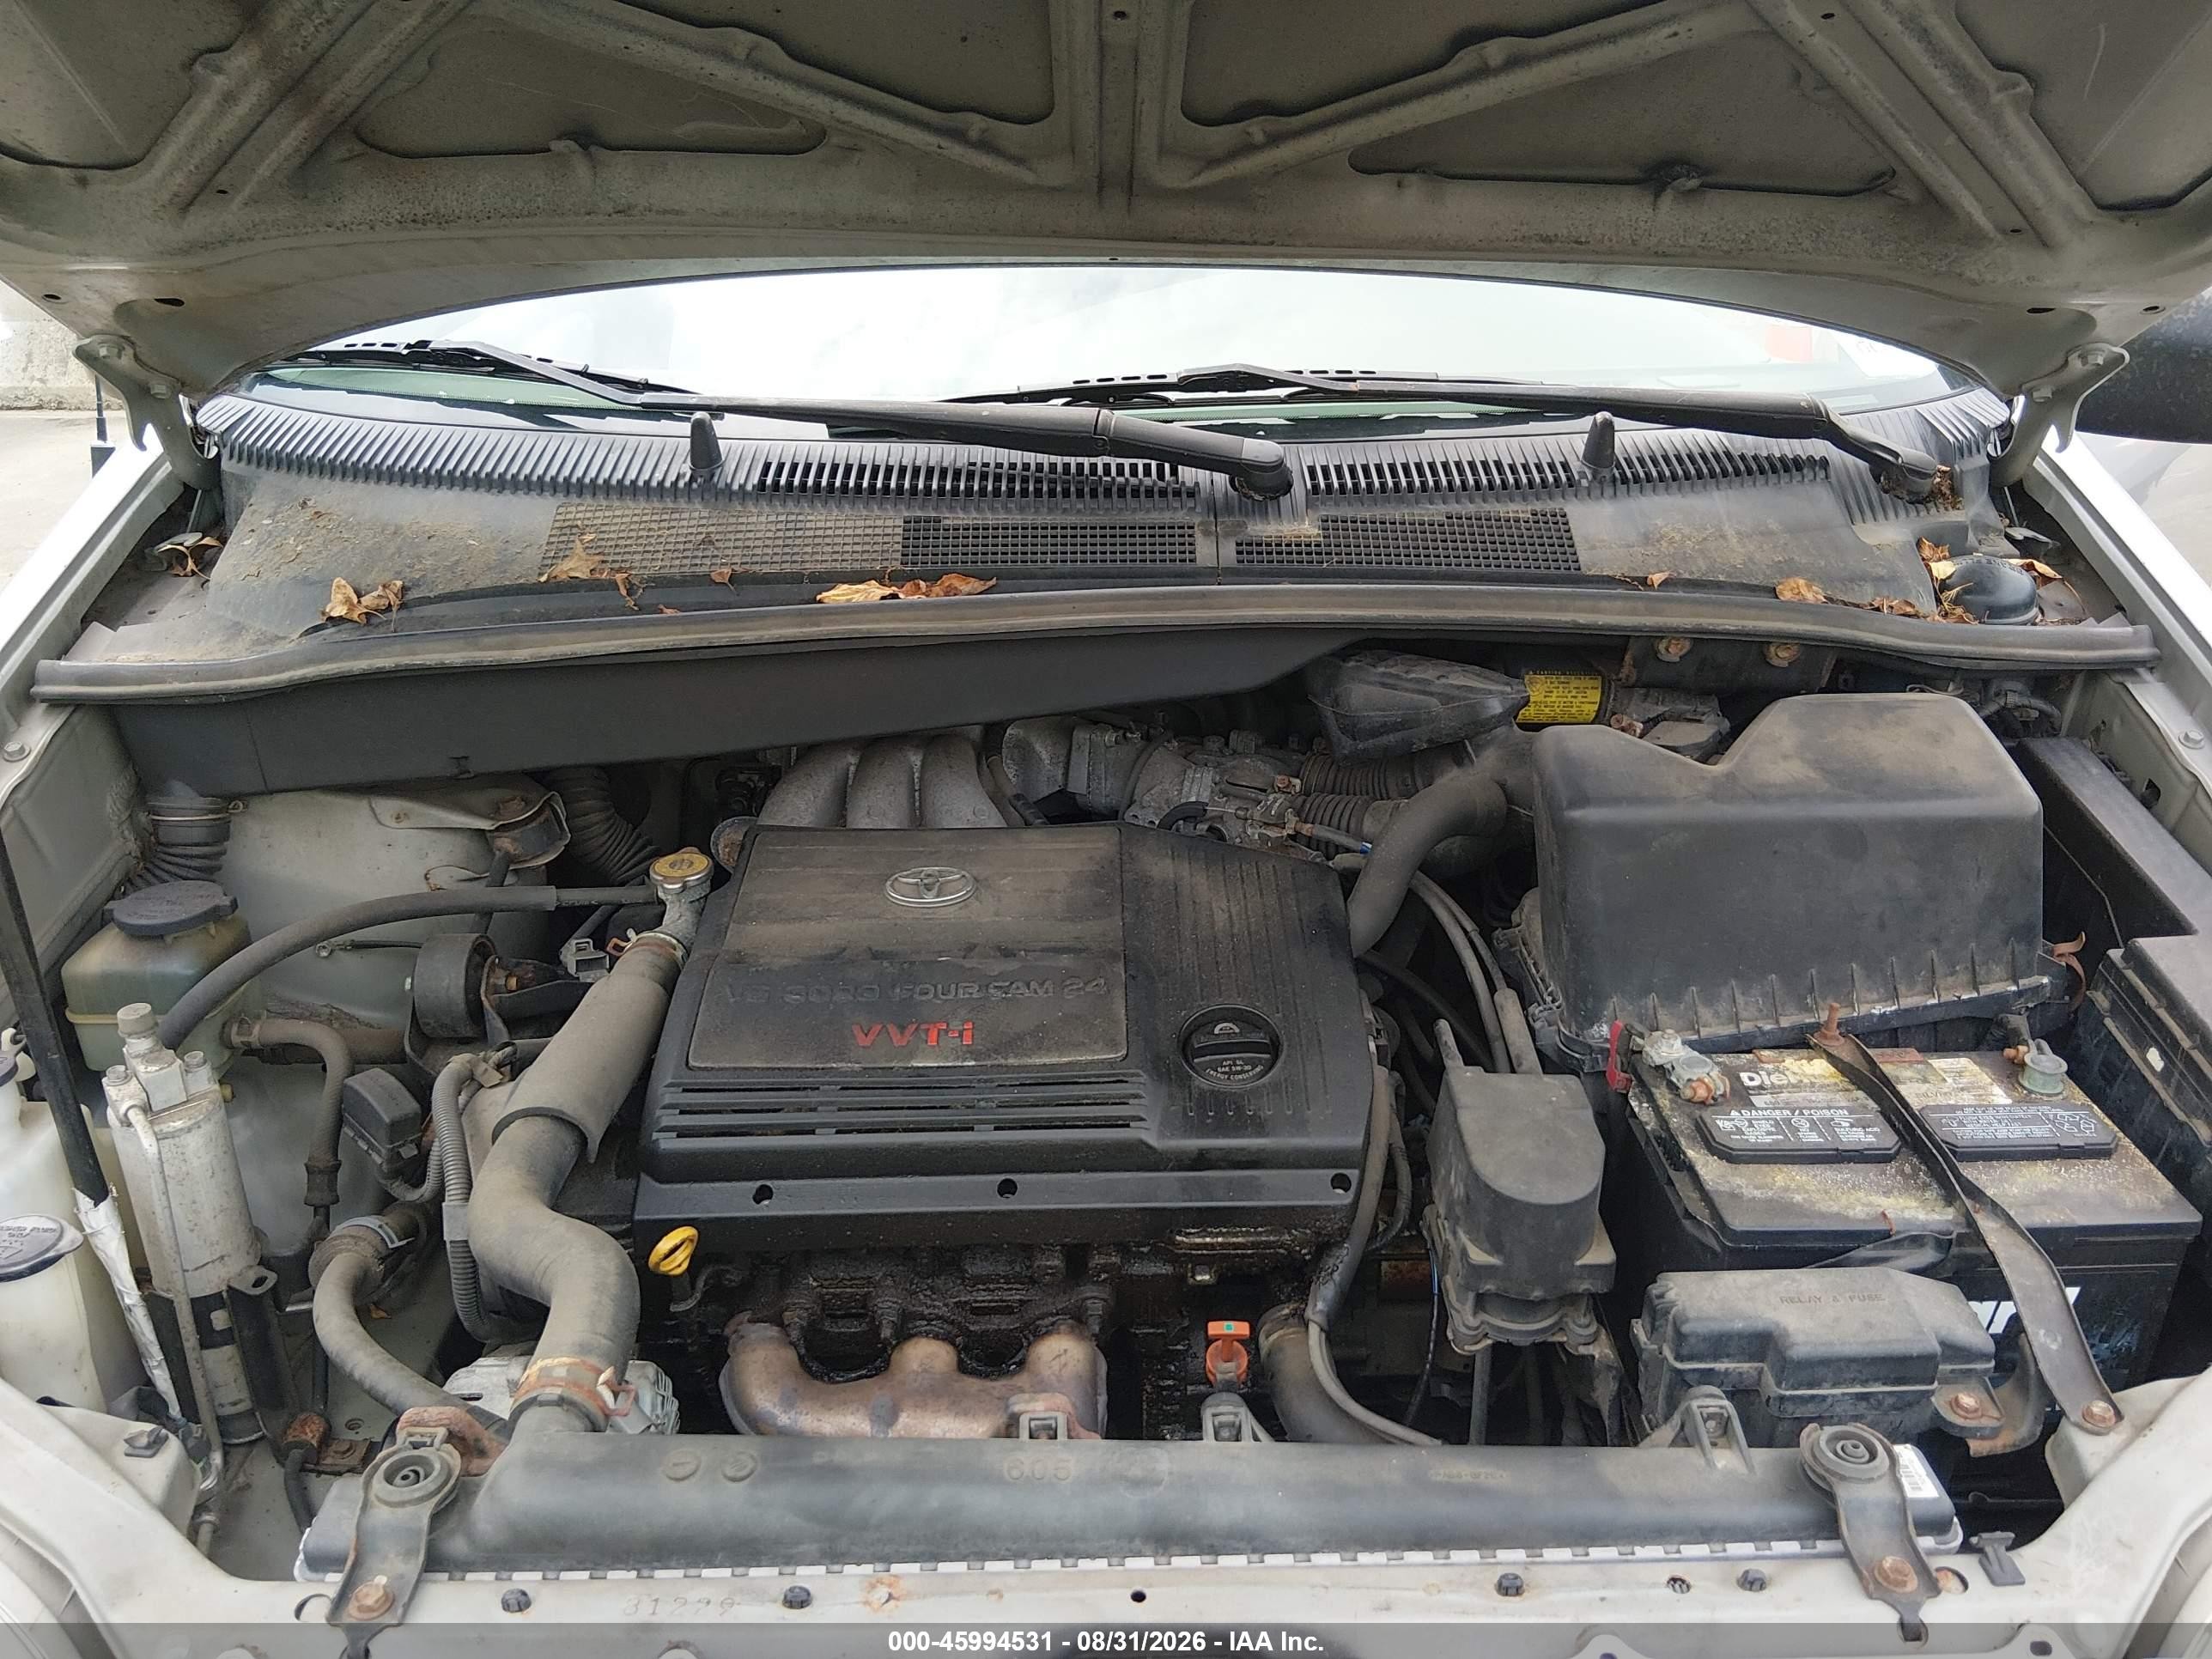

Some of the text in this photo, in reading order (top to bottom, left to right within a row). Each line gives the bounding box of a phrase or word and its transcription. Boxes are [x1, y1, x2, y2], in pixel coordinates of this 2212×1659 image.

[851, 1020, 974, 1048] VVT-i
[1778, 1294, 1823, 1305] RELAY
[1848, 1293, 1887, 1303] FUSE
